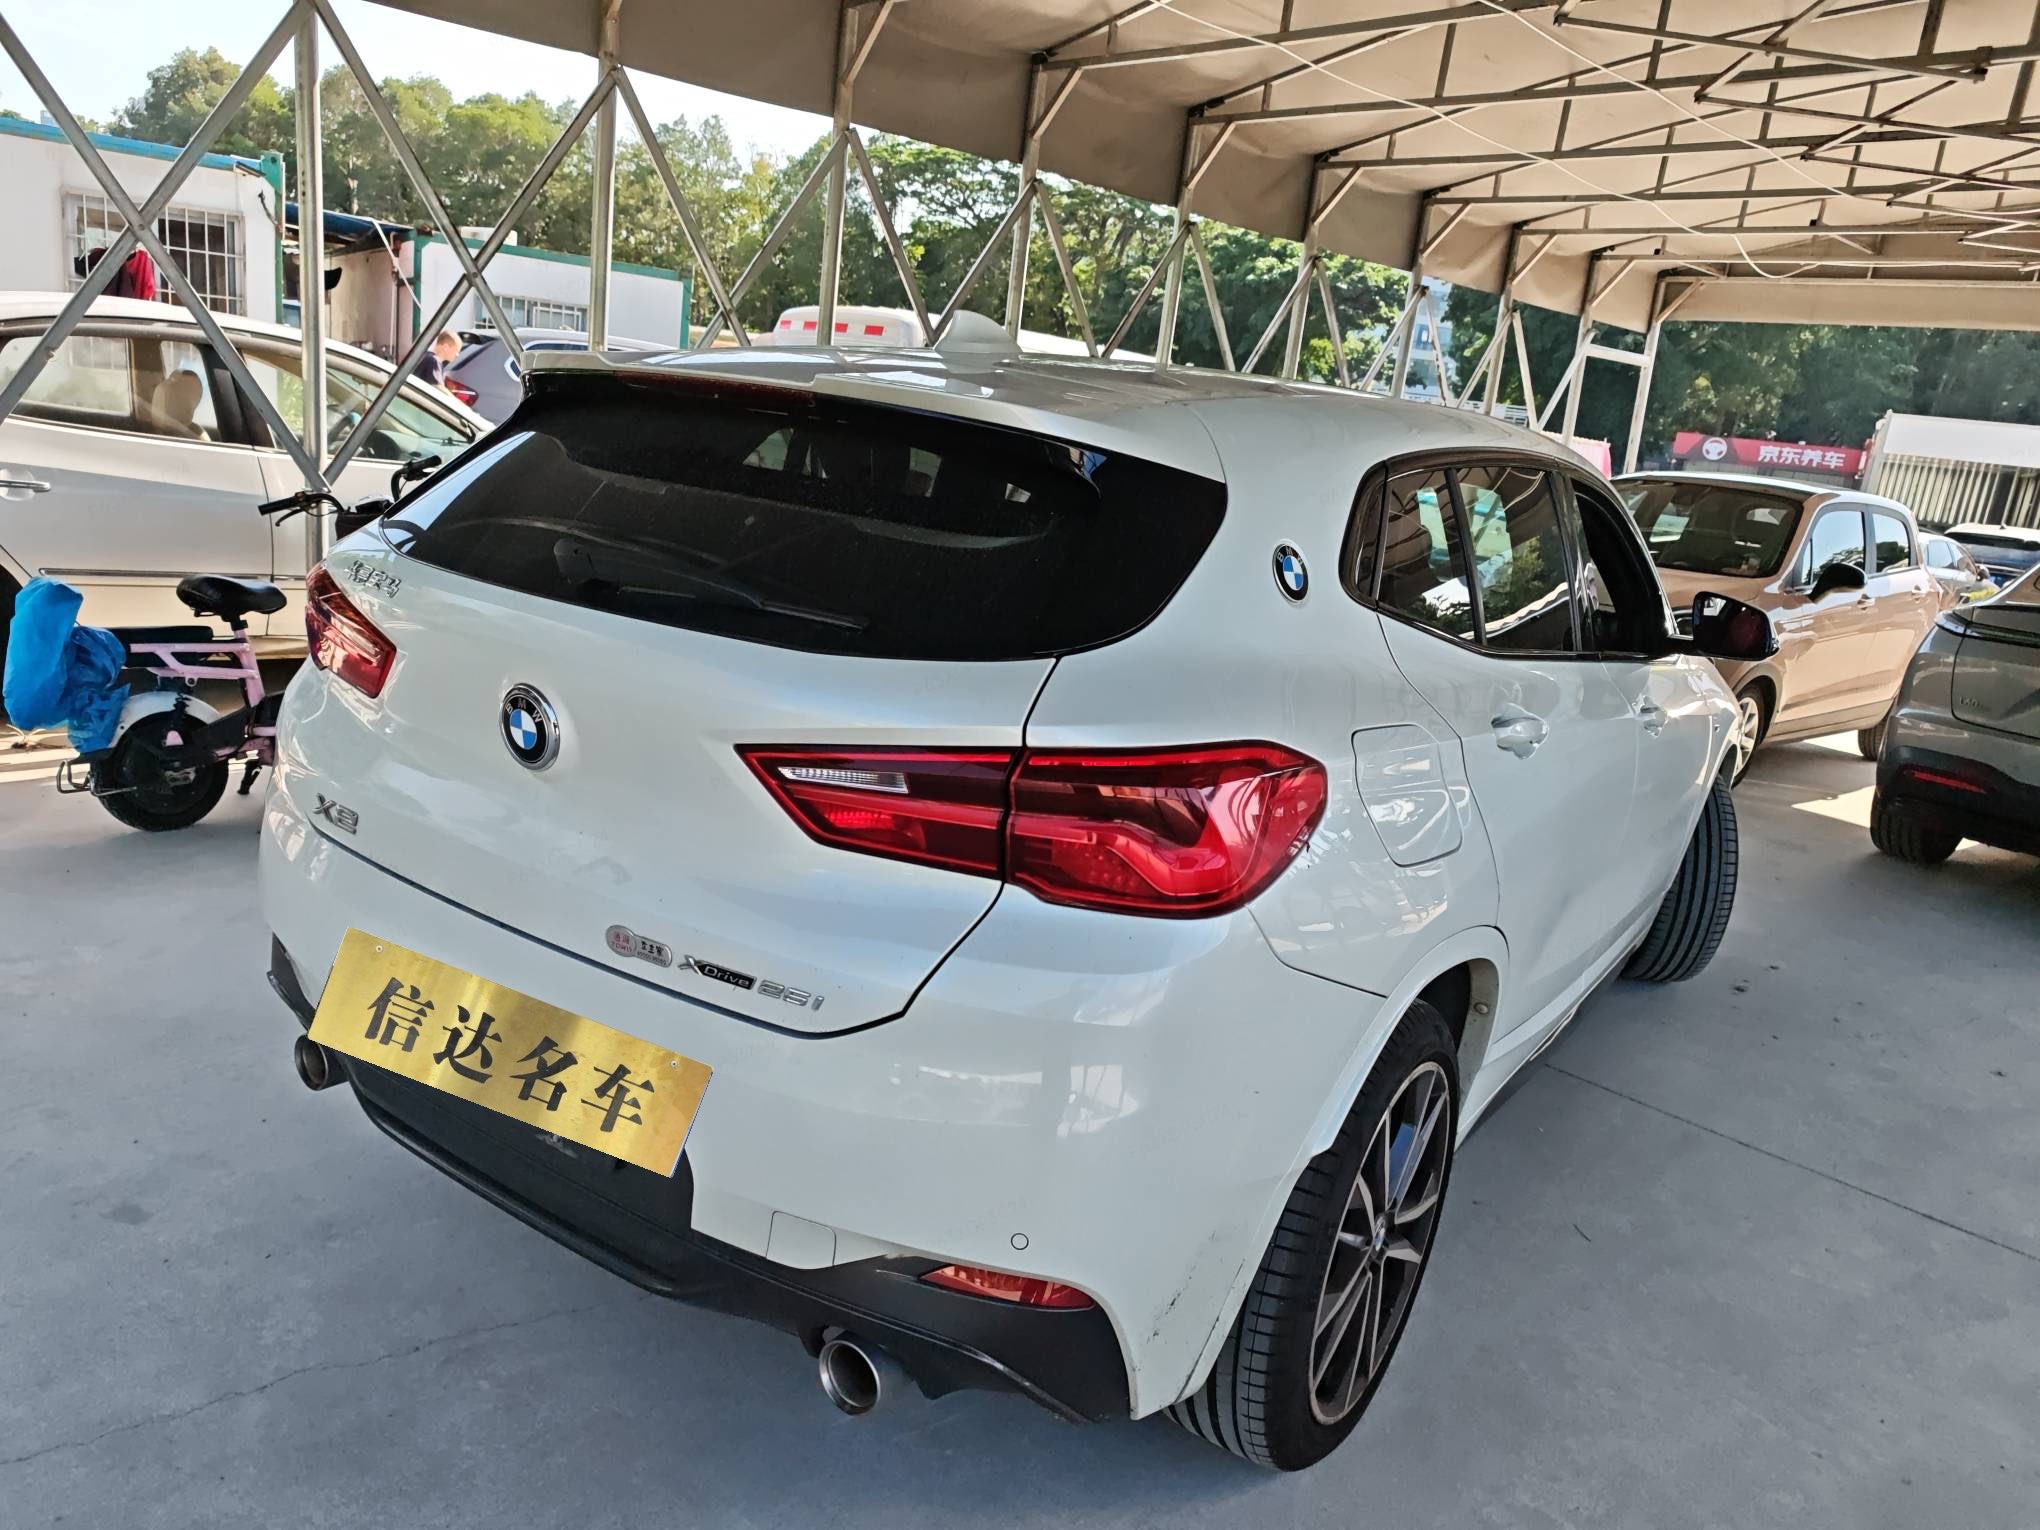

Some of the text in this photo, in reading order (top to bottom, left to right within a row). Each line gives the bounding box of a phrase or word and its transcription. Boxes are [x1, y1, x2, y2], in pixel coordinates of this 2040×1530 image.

[1758, 445, 1847, 469] 京东养车
[312, 793, 359, 836] X2
[364, 976, 655, 1133] 信达名车
